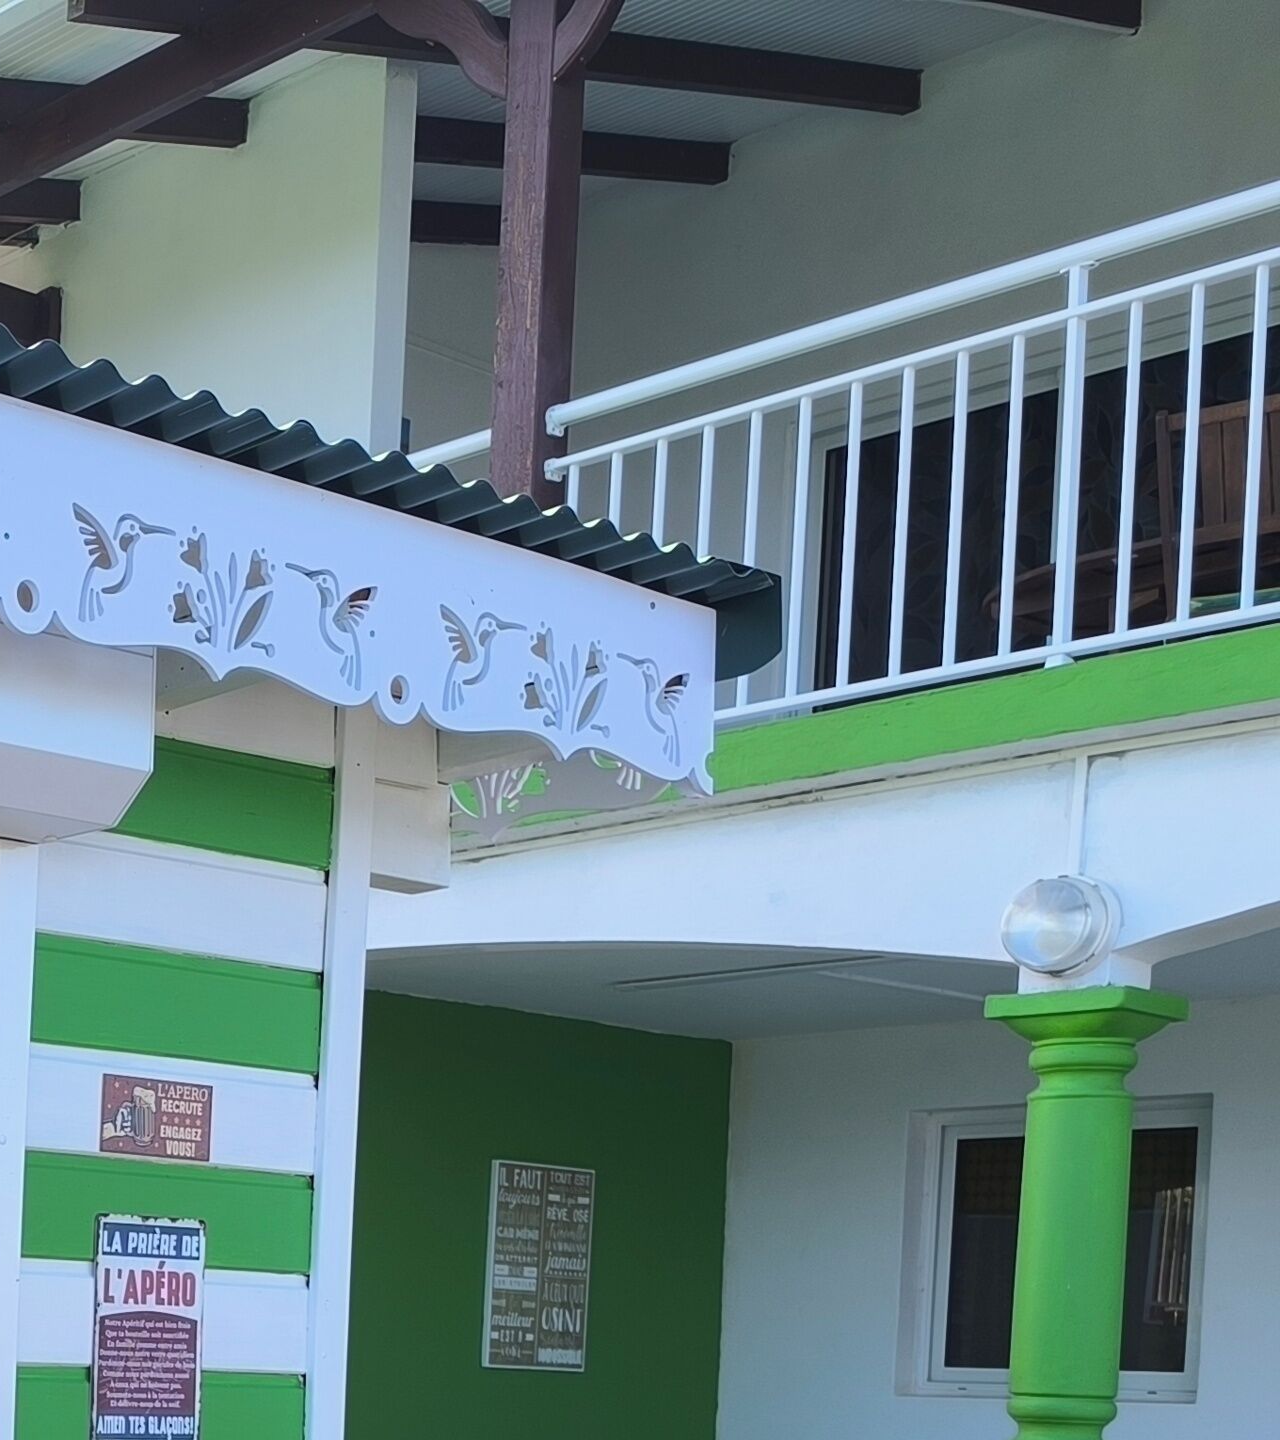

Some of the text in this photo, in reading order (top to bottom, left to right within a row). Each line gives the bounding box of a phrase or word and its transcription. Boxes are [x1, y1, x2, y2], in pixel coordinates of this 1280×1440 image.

[160, 1099, 203, 1116] RECRUTE
[160, 1125, 202, 1141] ENGAGEZ
[166, 1140, 195, 1157] VOUS!
[500, 1168, 543, 1189] IL FAUT
[550, 1171, 591, 1186] TOUT EST
[498, 1188, 540, 1209] toujours
[103, 1228, 199, 1257] LA PRIÈRE DE
[544, 1252, 586, 1274] jamais
[103, 1261, 196, 1307] L'APÉRO
[145, 1320, 154, 1328] qui
[491, 1312, 535, 1328] meilleur
[97, 1415, 194, 1440] AMEN TES GLAÇONS!
